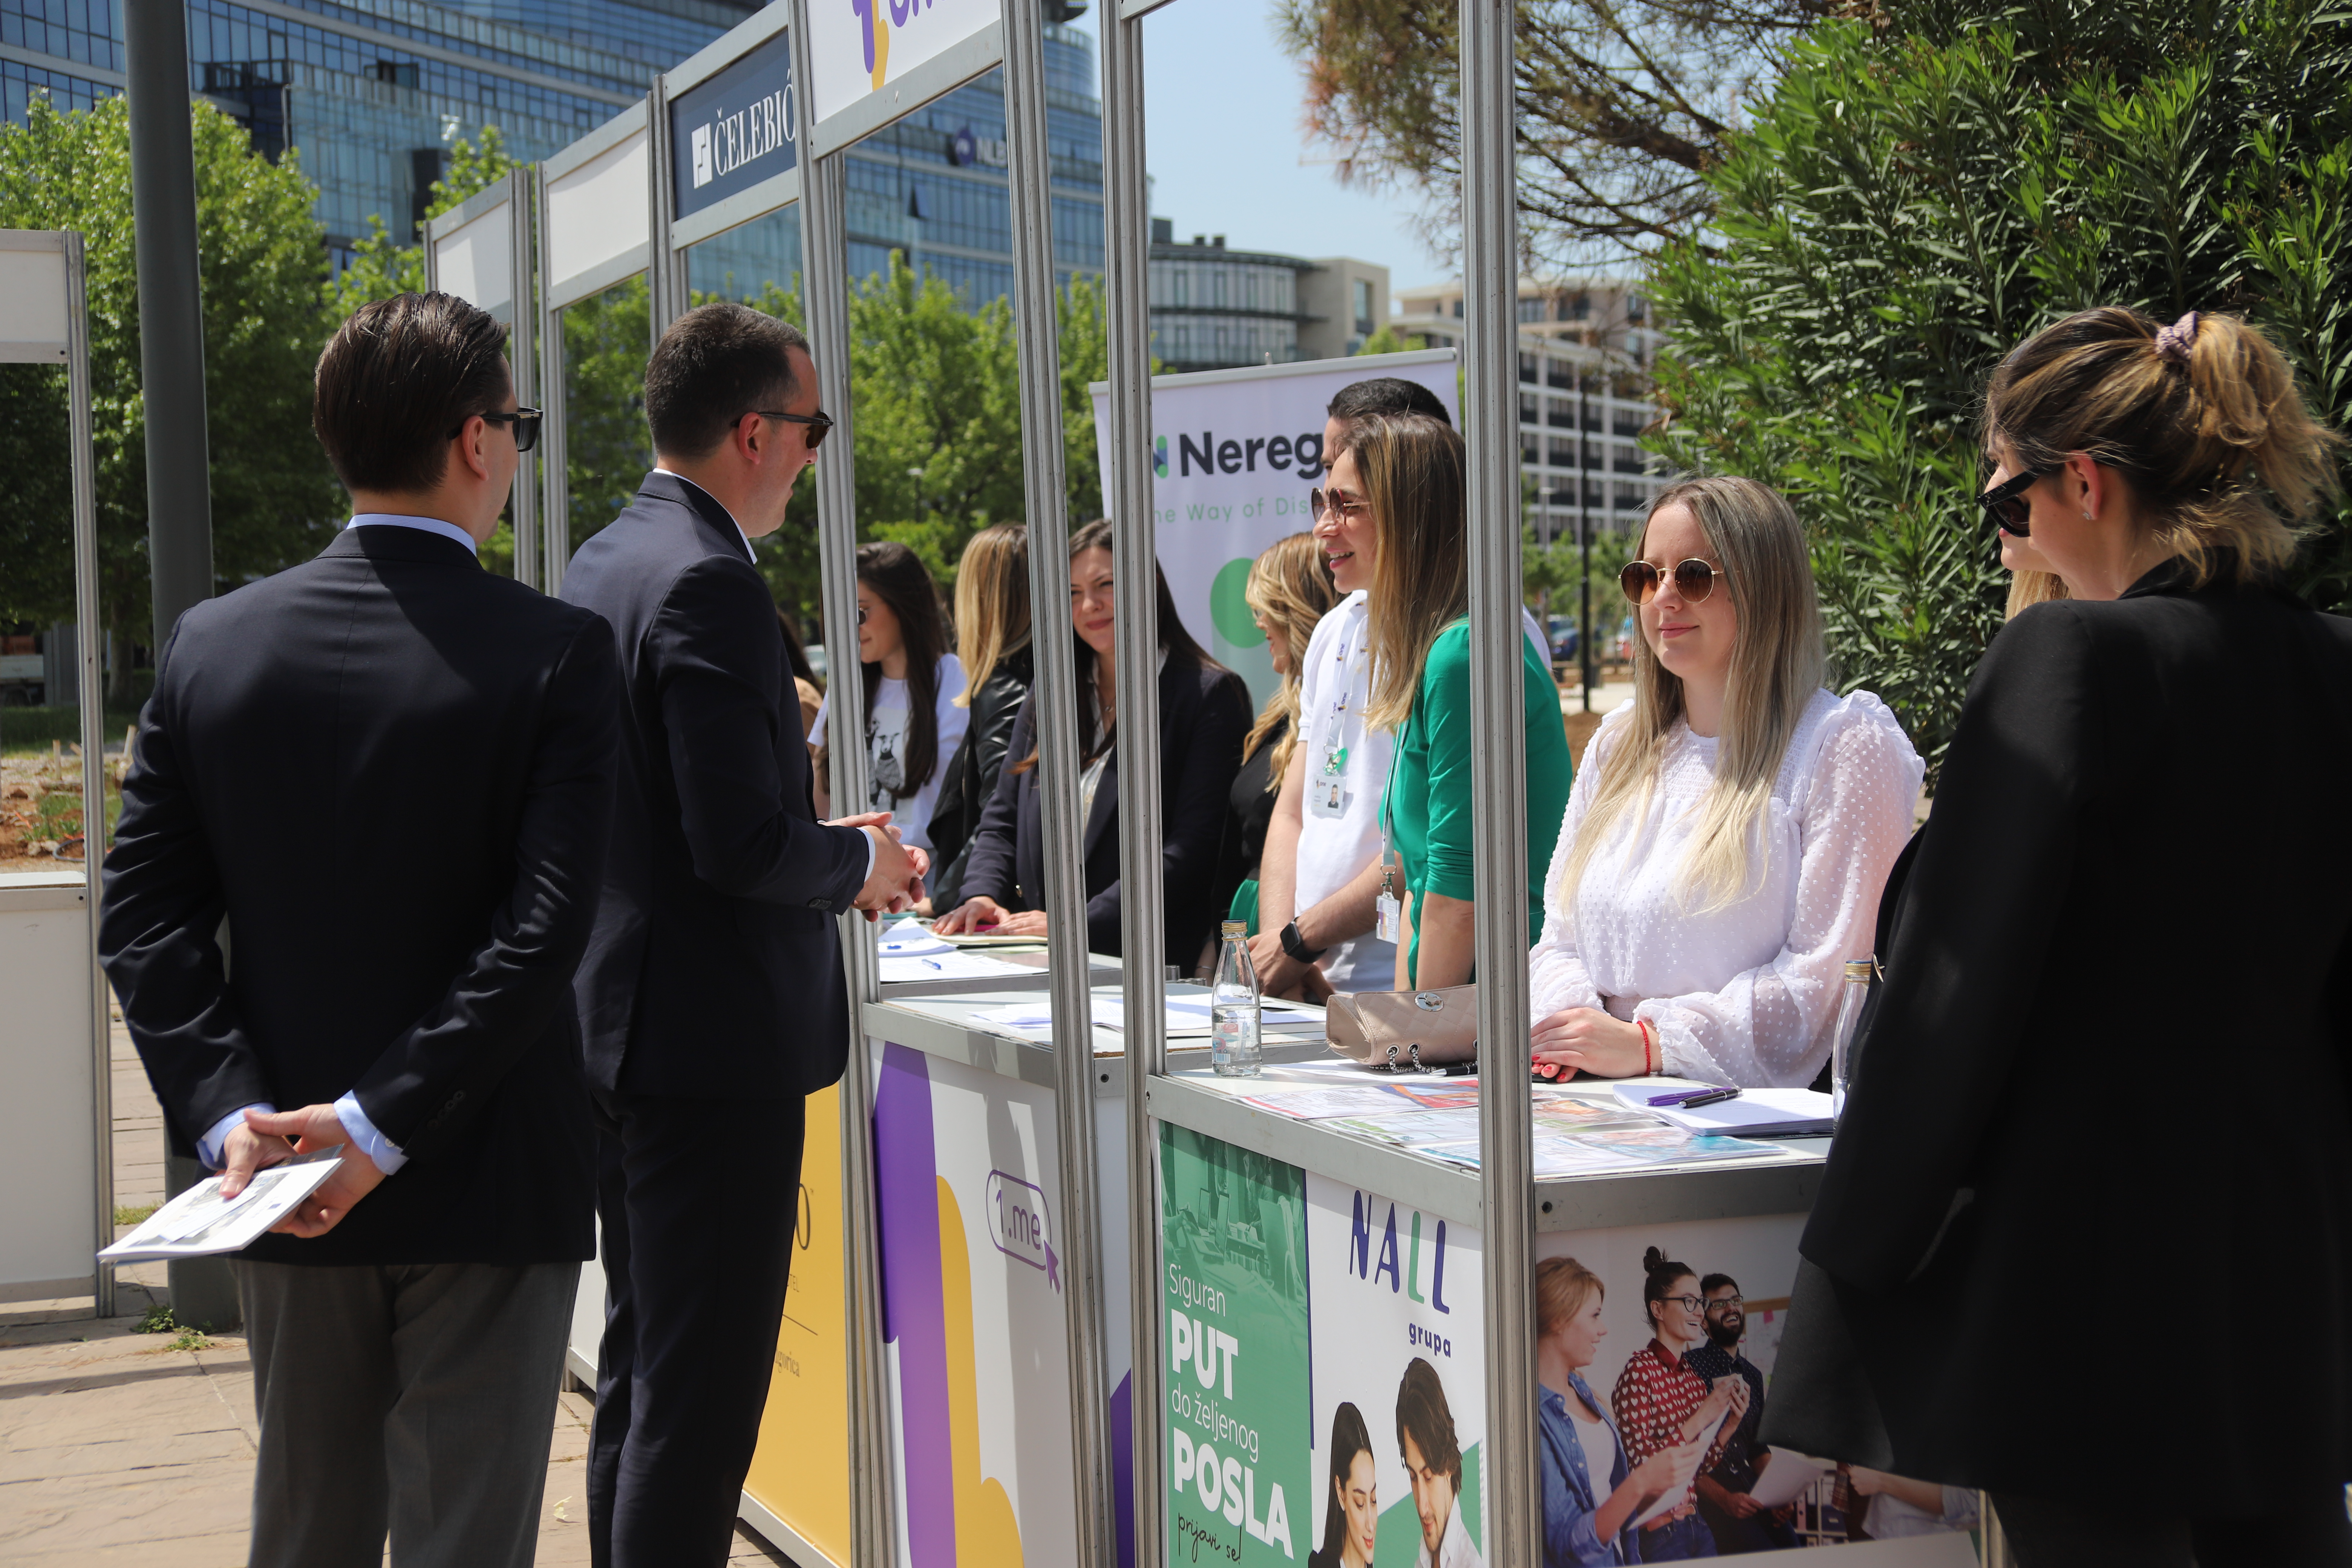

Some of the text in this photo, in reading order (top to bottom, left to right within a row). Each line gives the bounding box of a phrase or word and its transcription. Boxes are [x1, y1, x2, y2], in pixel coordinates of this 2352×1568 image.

[1187, 504, 1232, 522] Way
[1244, 498, 1264, 518] of
[996, 1190, 1041, 1250] 1.me
[1350, 1190, 1450, 1315] NALL
[1170, 1263, 1225, 1317] Siguran
[1171, 1308, 1239, 1401] PUT
[1409, 1323, 1451, 1358] grupa
[1172, 1382, 1259, 1463] do željenog
[1173, 1427, 1294, 1560] POSLA
[1178, 1512, 1242, 1565] prijavi se!
